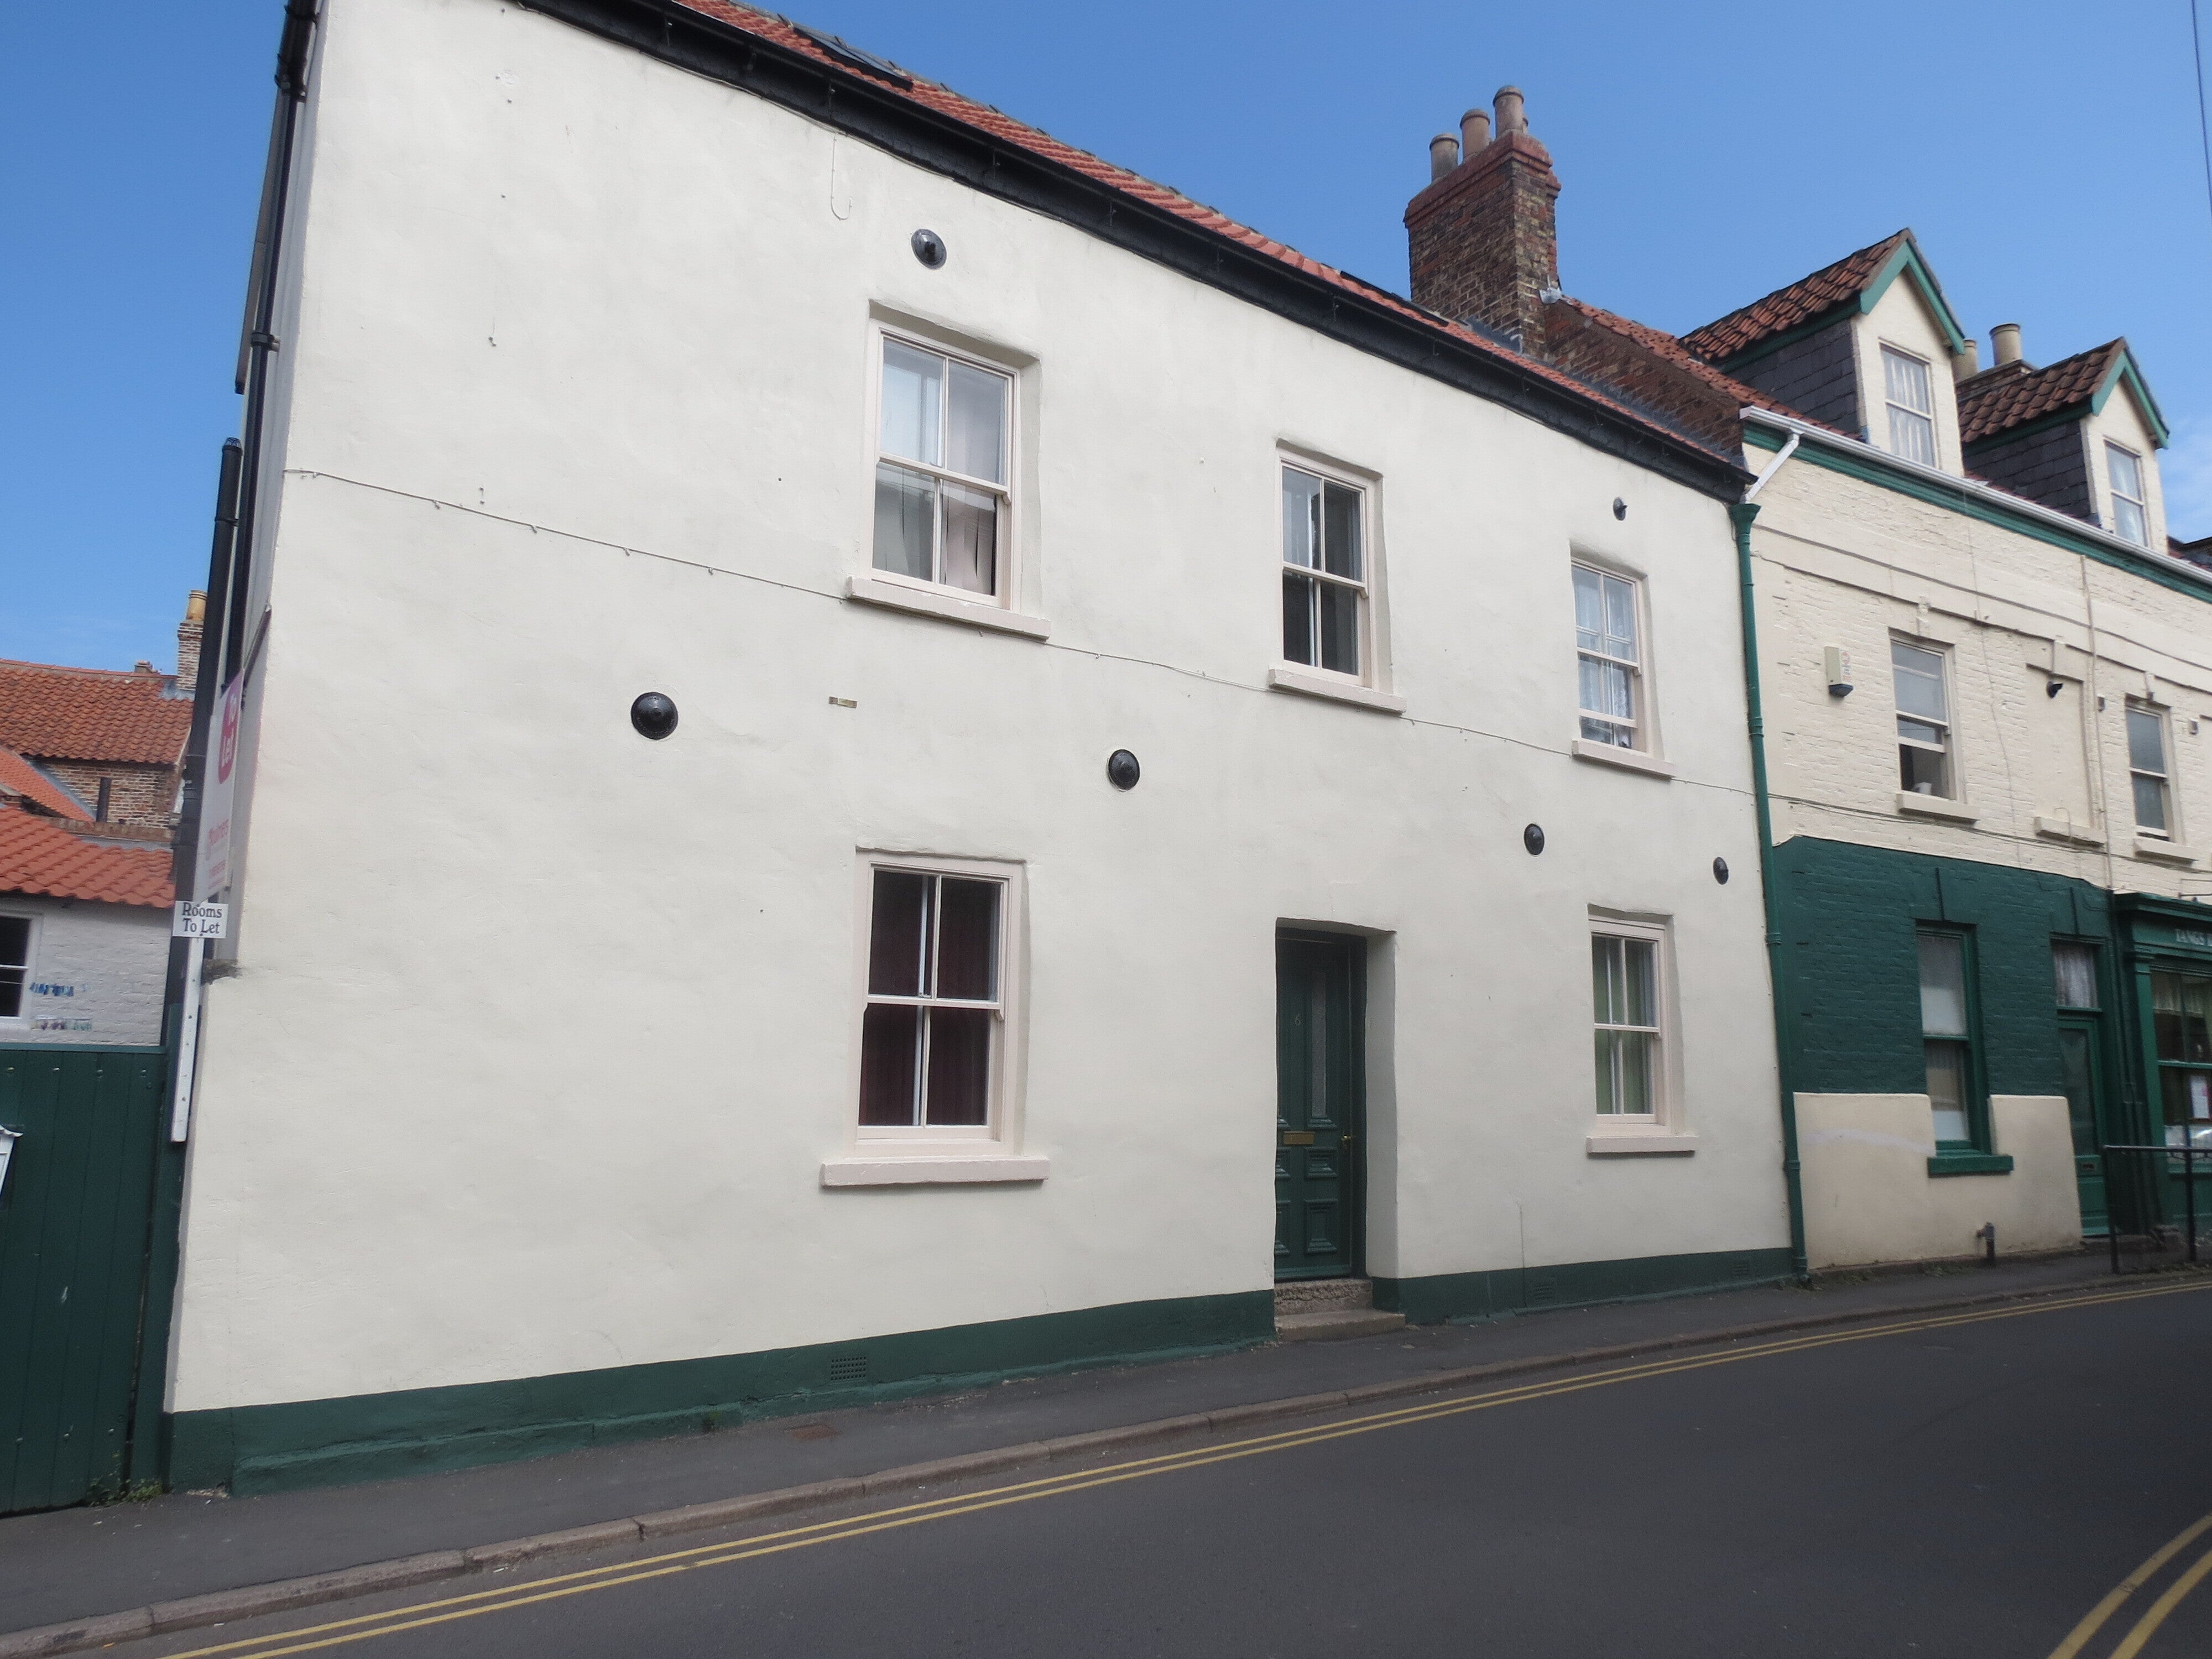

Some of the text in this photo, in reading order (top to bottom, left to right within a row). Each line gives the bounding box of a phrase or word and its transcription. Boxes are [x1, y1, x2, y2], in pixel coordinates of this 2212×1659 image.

[222, 727, 235, 768] Let
[182, 902, 222, 918] Rooms
[182, 918, 220, 934] To Let
[1295, 1014, 1301, 1026] 6
